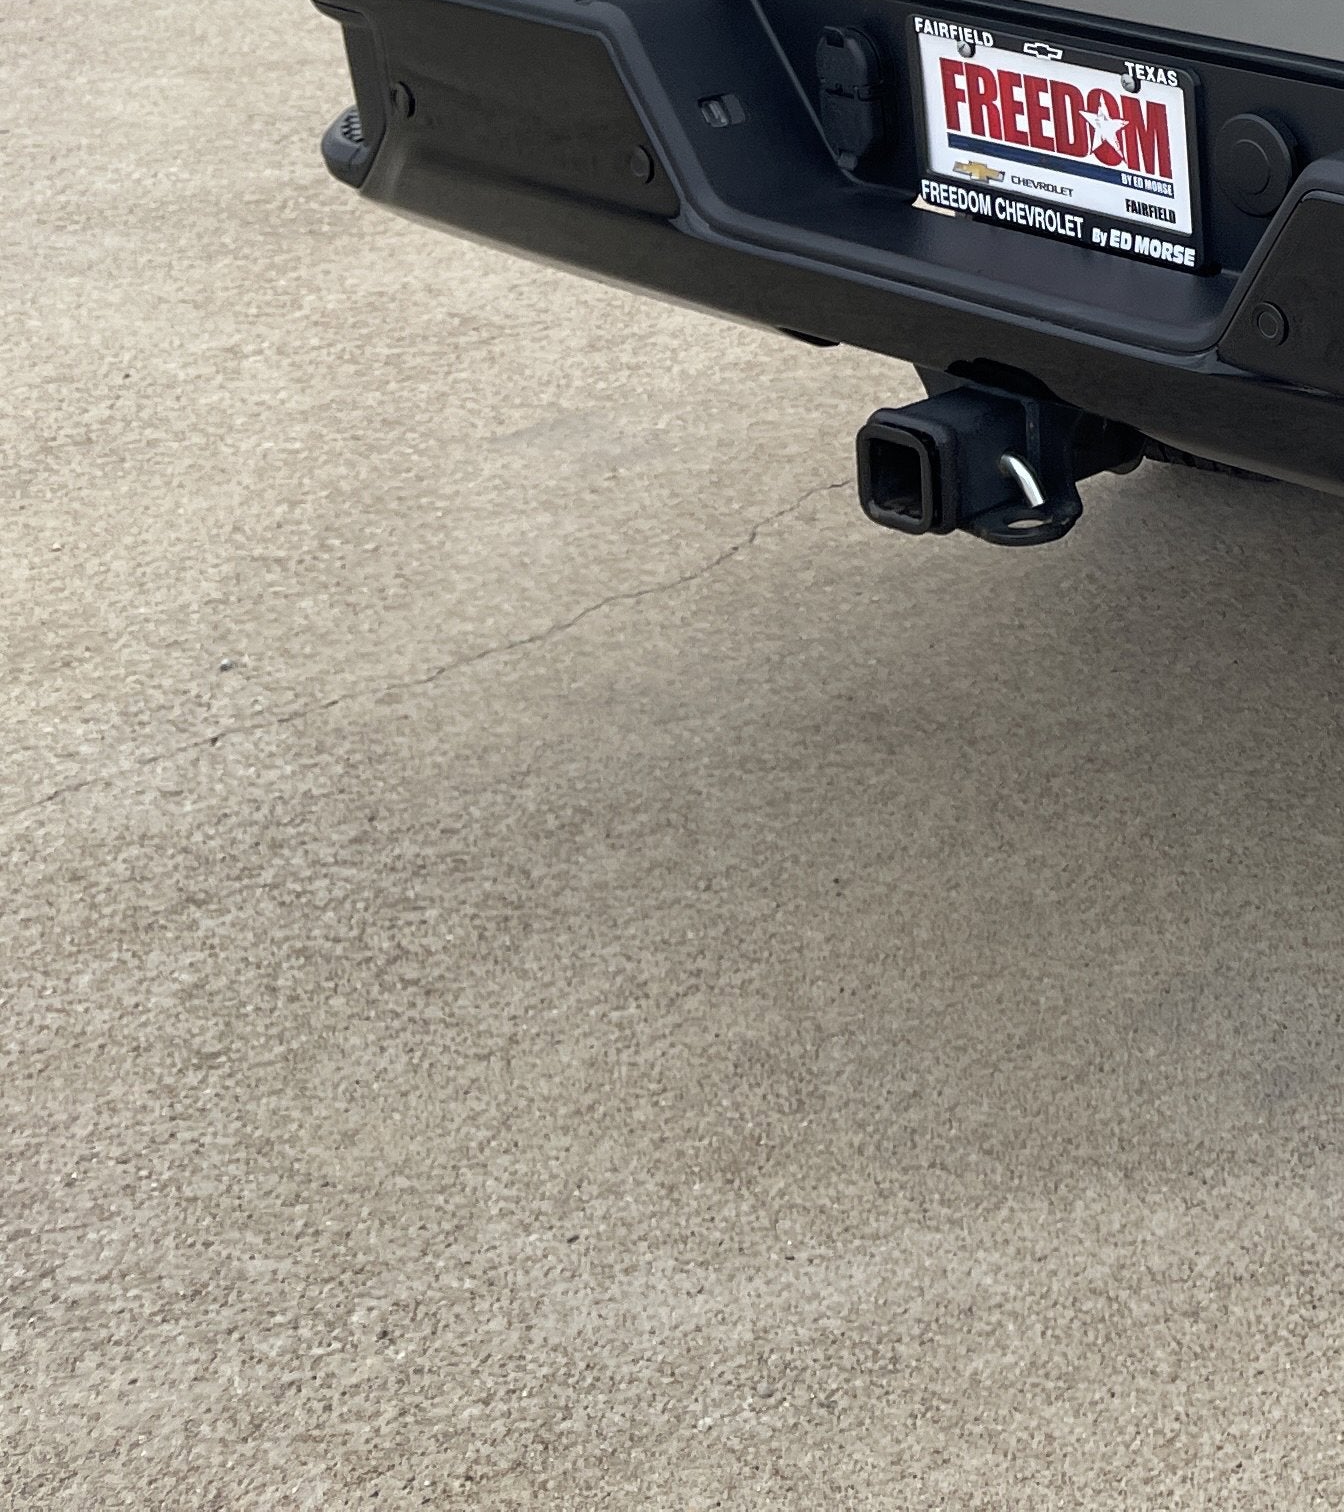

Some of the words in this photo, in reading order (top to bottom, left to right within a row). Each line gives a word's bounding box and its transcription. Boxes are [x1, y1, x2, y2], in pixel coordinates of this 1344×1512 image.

[914, 16, 994, 47] FAIRFIELD
[1124, 61, 1178, 87] TEXAS
[939, 57, 1174, 180] FREEDOM
[1011, 175, 1074, 197] CHEVROLET
[1121, 173, 1133, 185] BY
[1133, 176, 1144, 189] ED
[1144, 178, 1173, 196] MORSE
[921, 179, 992, 216] FREEDOM
[995, 197, 1084, 238] CHEVROLET
[1092, 227, 1108, 247] By
[1109, 228, 1132, 251] ED
[1134, 234, 1195, 267] MORSE
[1125, 198, 1176, 224] FAIRFIELD
